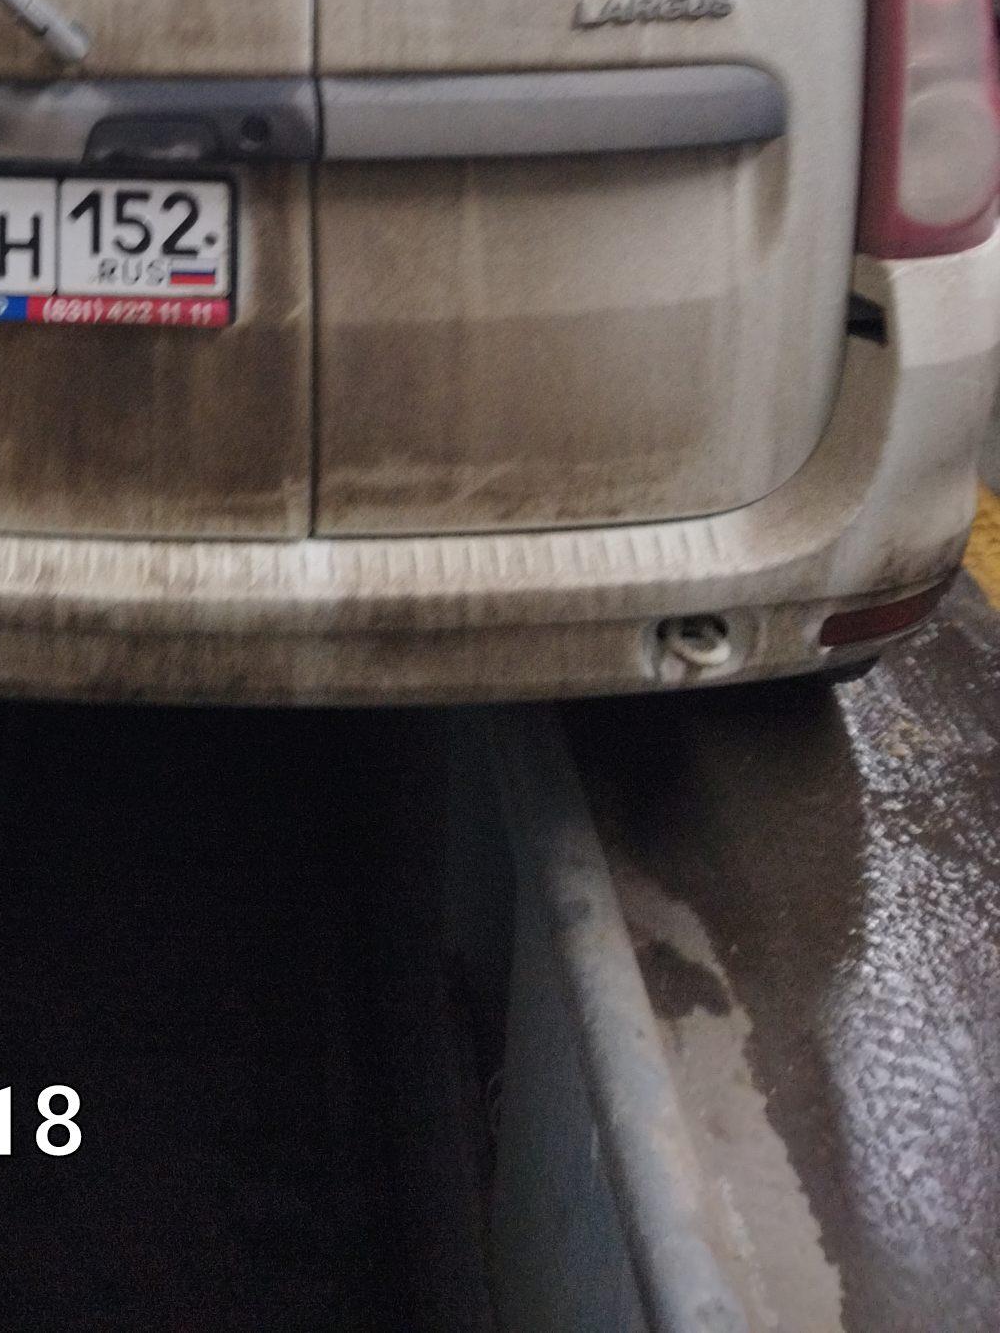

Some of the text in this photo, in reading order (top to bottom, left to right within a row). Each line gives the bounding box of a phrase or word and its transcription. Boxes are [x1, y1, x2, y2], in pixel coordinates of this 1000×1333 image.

[67, 189, 200, 256] 152
[95, 257, 165, 286] RUS
[107, 299, 154, 323] 422
[158, 301, 183, 325] 11
[190, 302, 214, 326] 11
